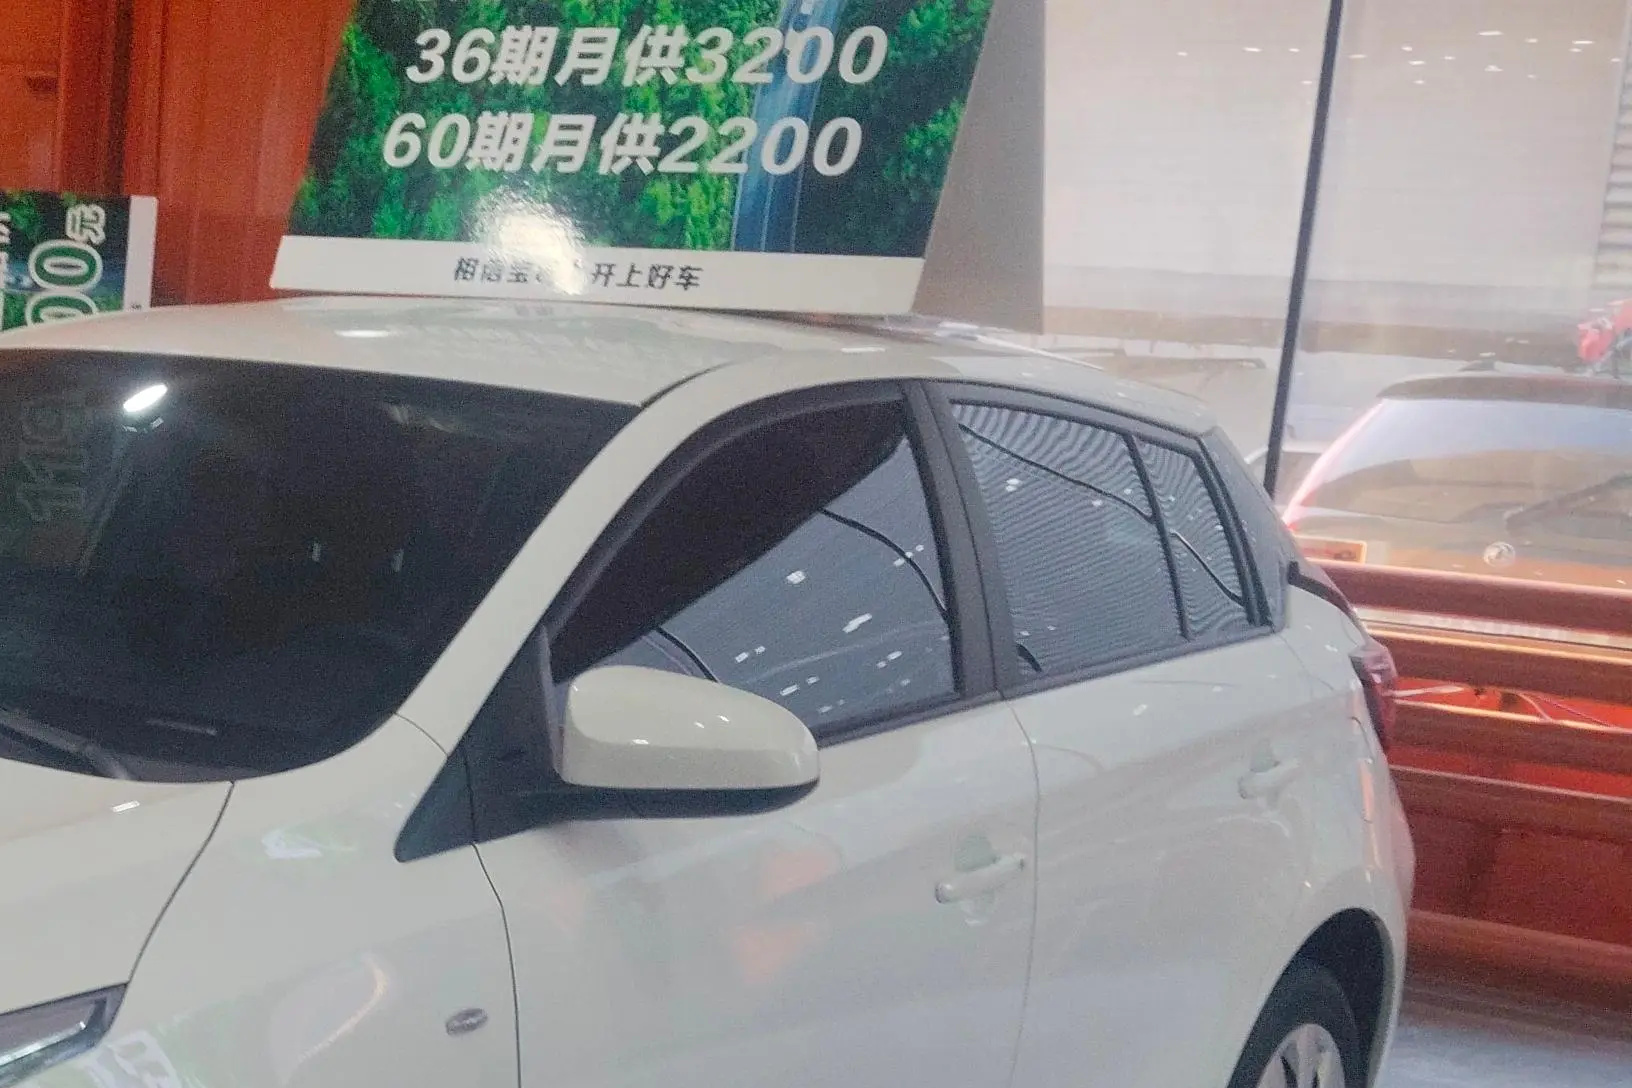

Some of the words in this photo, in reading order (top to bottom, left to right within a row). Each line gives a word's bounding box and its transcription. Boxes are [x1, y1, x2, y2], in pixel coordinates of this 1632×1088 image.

[405, 26, 889, 86] 36期月供3200
[381, 111, 863, 176] 60期月供2200
[592, 262, 703, 291] 开上好车
